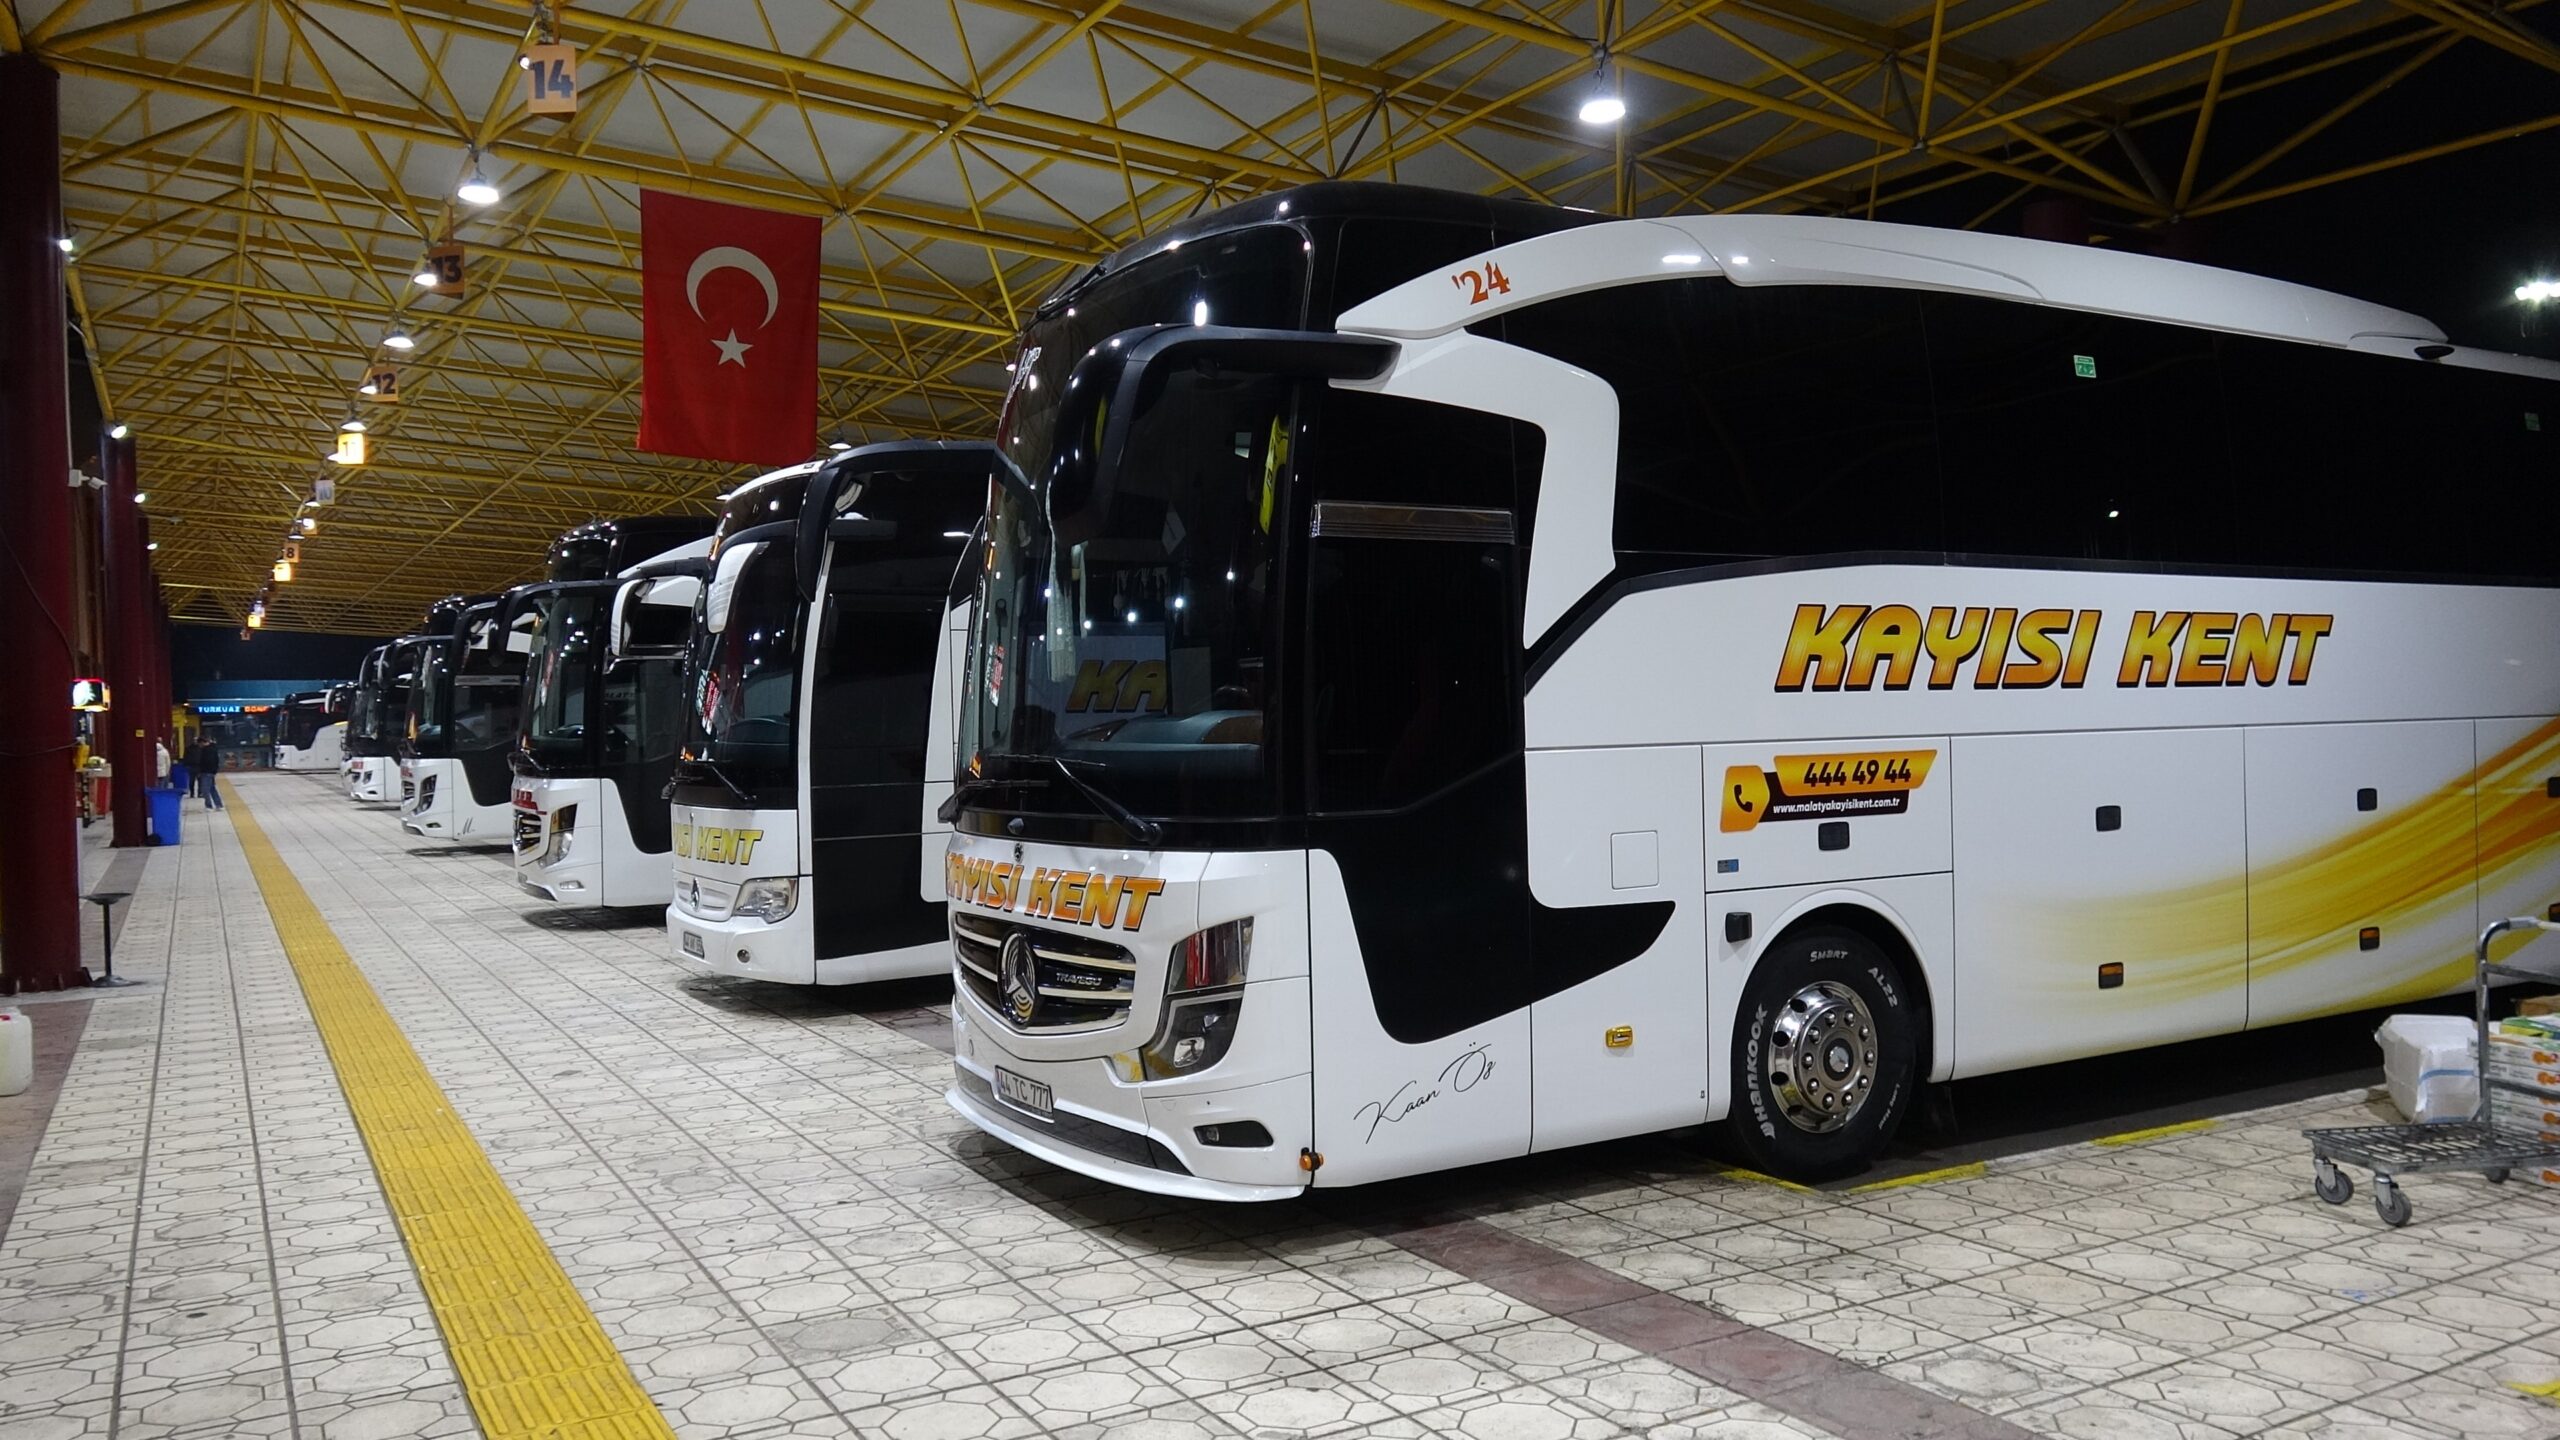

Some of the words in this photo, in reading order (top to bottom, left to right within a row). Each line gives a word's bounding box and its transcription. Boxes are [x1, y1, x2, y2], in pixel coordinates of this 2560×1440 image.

[530, 59, 574, 99] 14
[431, 255, 463, 283] 13
[1451, 260, 1511, 305] '24
[372, 373, 396, 395] 12
[286, 547, 295, 559] 8
[1774, 604, 2102, 692] KAYISI
[2116, 611, 2334, 688] KENT
[1803, 761, 1847, 788] 444
[1852, 759, 1880, 785] 49
[1884, 758, 1912, 783] 44
[1773, 797, 1900, 814] www.malatyakayisikent.com.tr
[696, 826, 764, 866] KENT
[1024, 866, 1167, 932] KENT
[1055, 972, 1103, 986] TRAVEGO
[1013, 1076, 1027, 1101] TC
[1031, 1083, 1049, 1110] 777
[1353, 1080, 1440, 1144] Kaan
